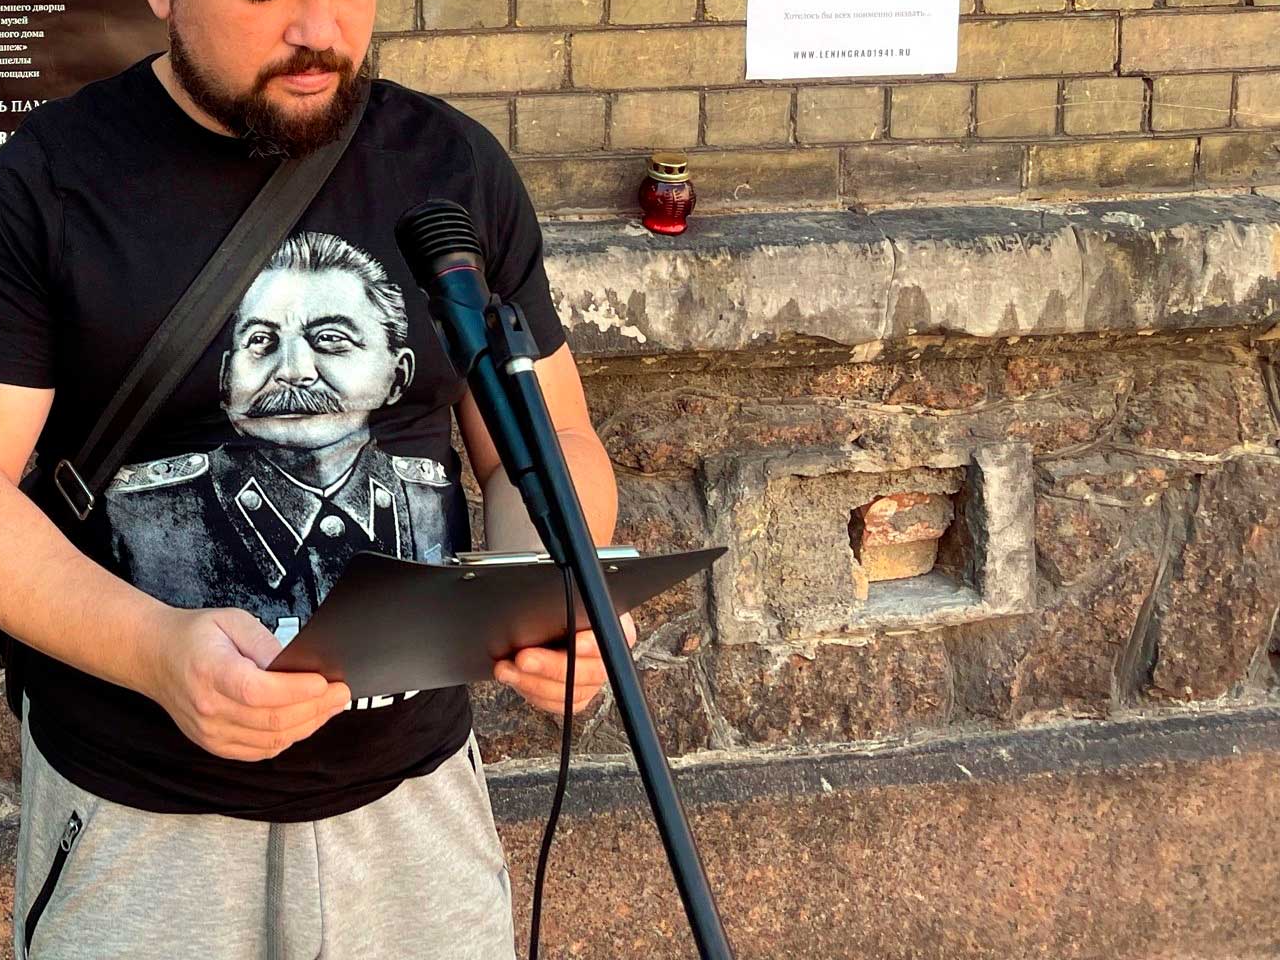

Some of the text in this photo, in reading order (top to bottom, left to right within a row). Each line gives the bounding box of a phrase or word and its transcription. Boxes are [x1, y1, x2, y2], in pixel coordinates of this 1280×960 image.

[32, 3, 65, 12] дворца
[1, 16, 28, 27] музей
[22, 29, 44, 39] дома
[793, 49, 911, 60] WWW.LENINGRAD1941.RU
